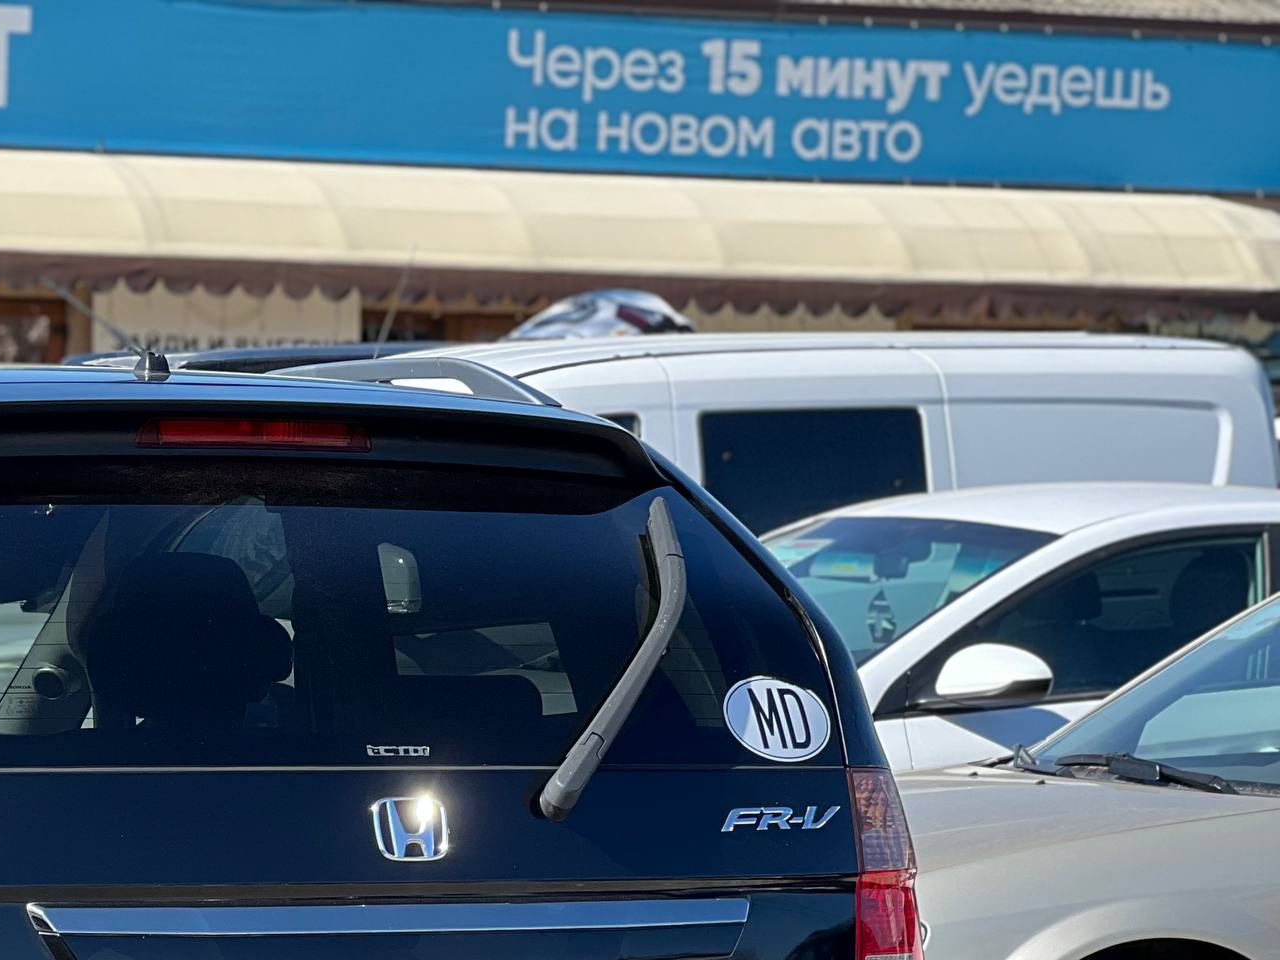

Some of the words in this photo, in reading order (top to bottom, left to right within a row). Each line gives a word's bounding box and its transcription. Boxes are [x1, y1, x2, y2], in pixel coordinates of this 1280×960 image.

[507, 28, 685, 102] Через
[700, 37, 762, 96] 15
[775, 54, 950, 115] минут
[962, 61, 1172, 118] уедешь
[504, 105, 579, 152] на
[596, 109, 775, 159] новом
[791, 117, 922, 163] авто
[747, 687, 812, 750] MD
[721, 805, 841, 832] FR-V
